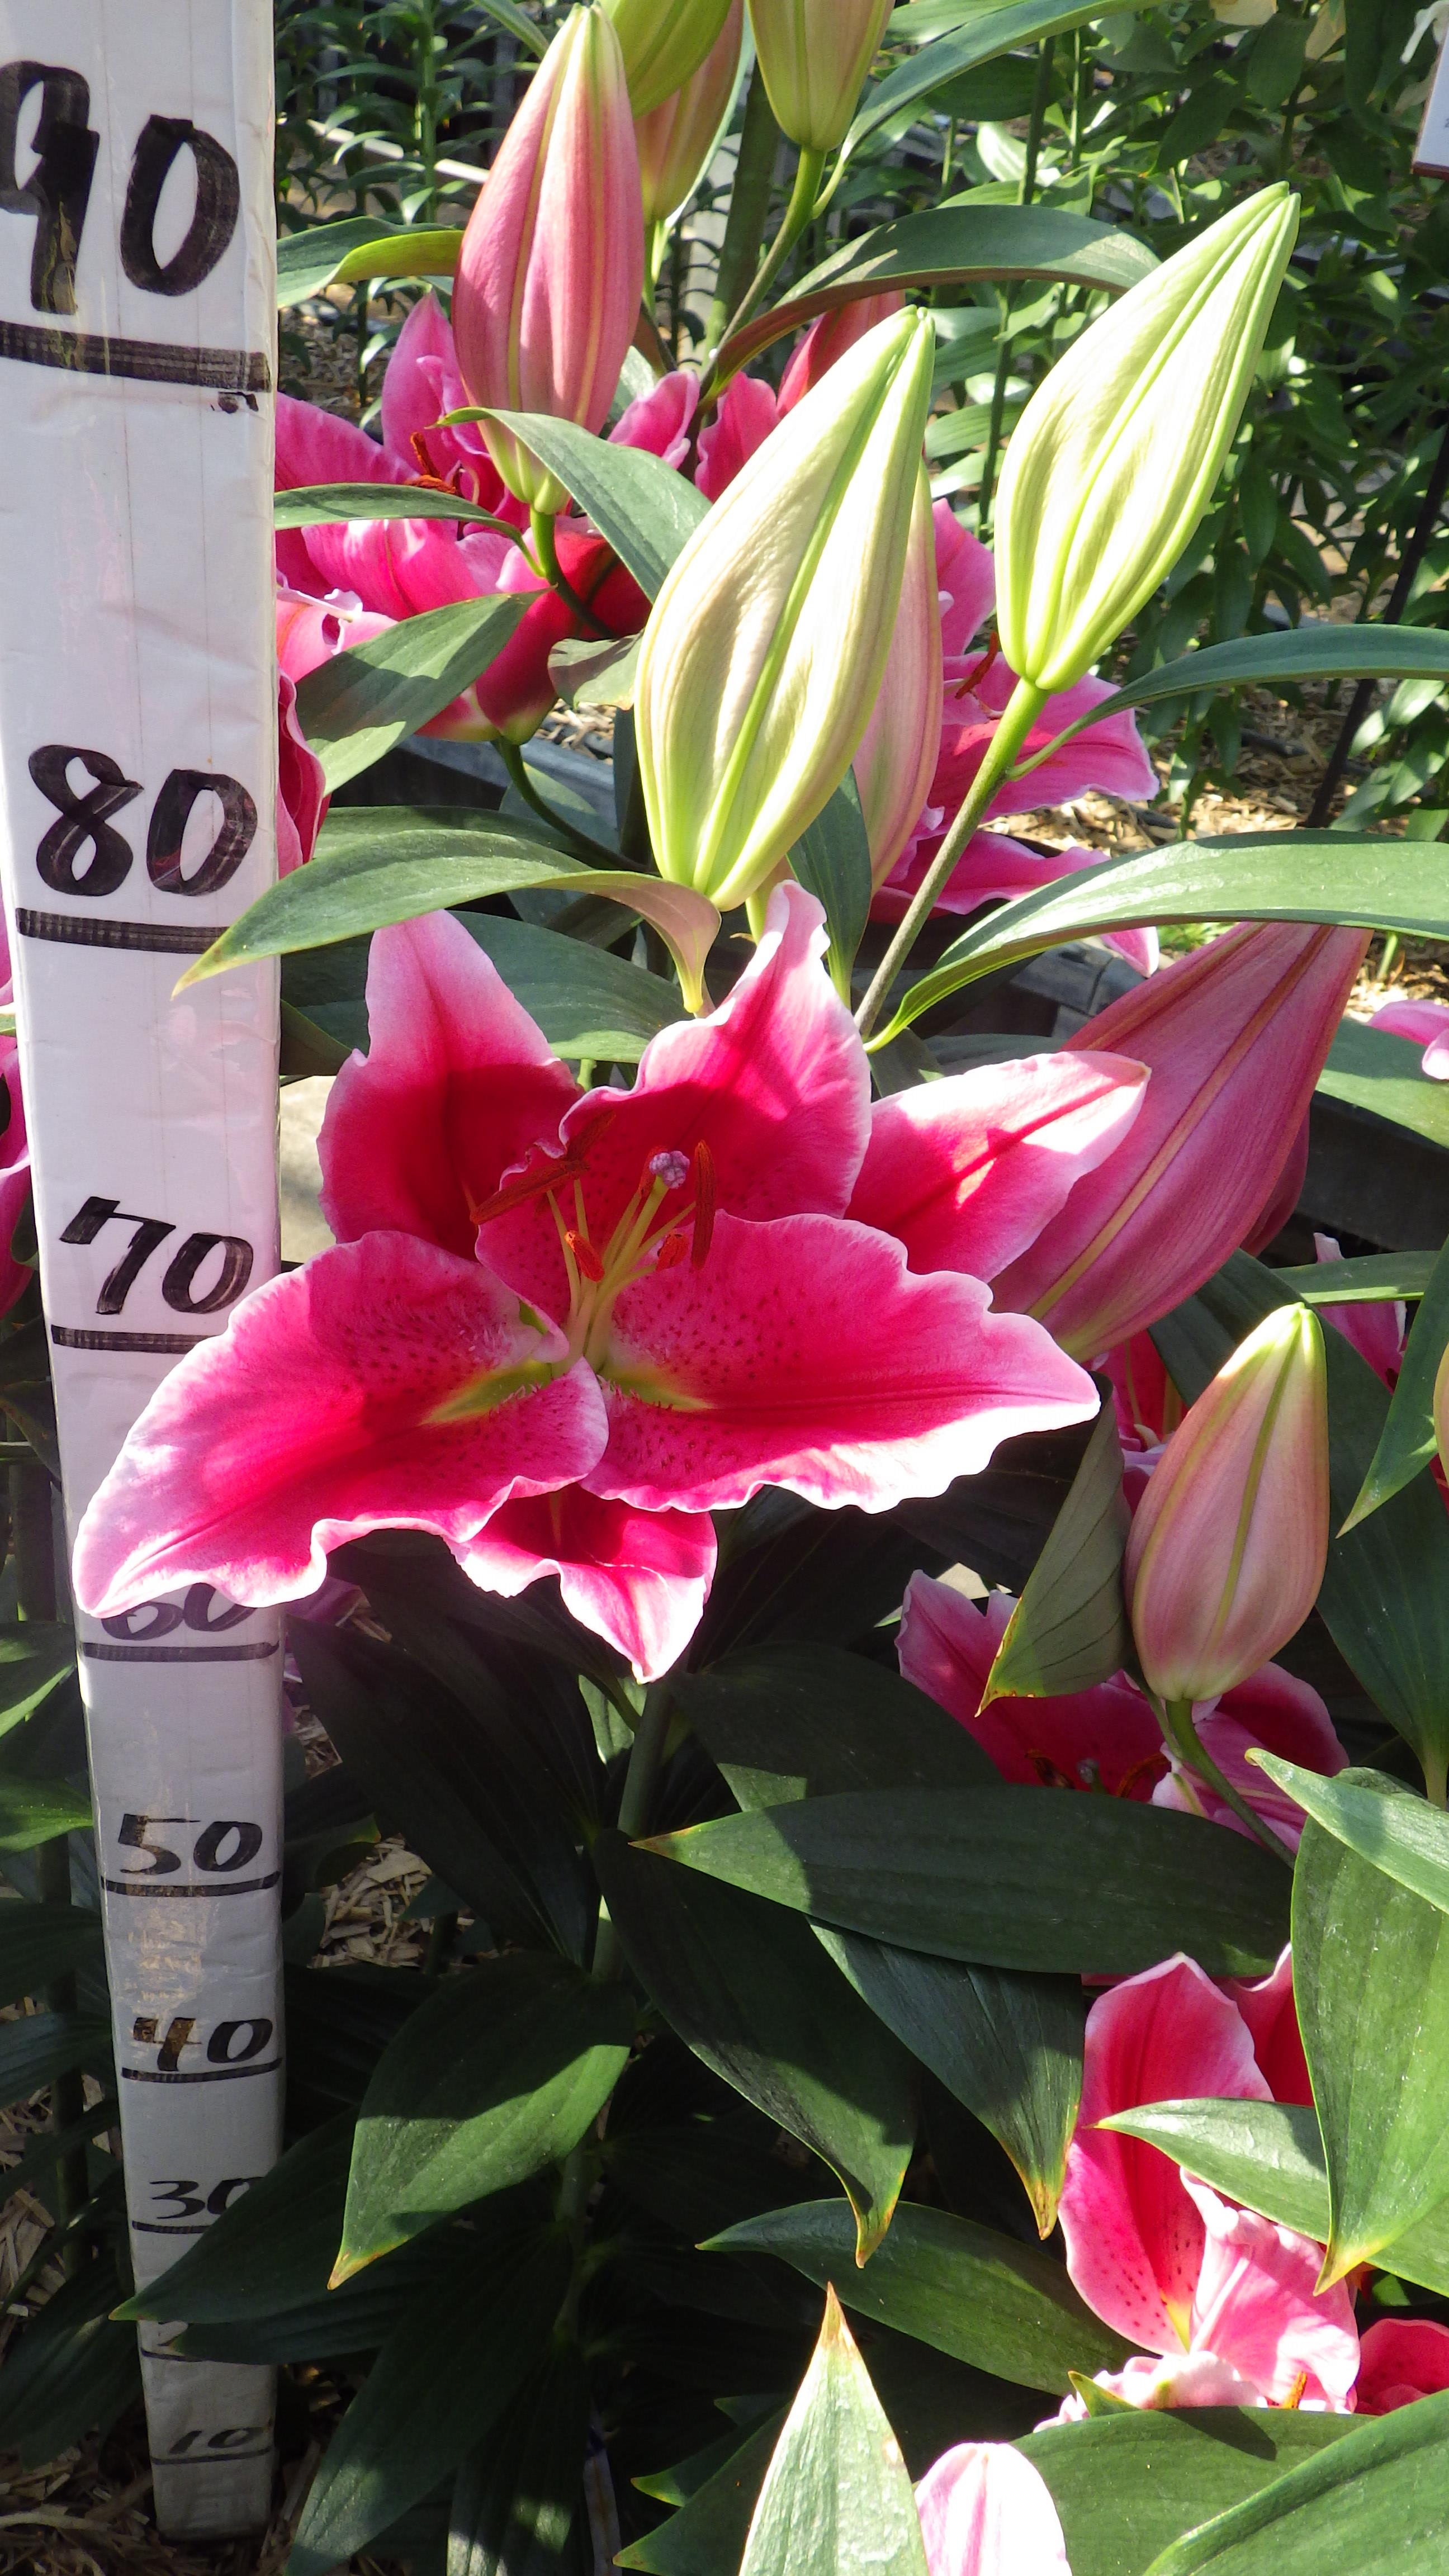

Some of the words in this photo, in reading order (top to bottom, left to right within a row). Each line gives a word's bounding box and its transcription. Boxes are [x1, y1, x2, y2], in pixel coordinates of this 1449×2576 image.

[0, 60, 240, 315] 90
[29, 744, 258, 897] 80
[59, 1196, 253, 1315] 70
[118, 1813, 263, 1875] 50
[131, 2017, 273, 2072] 40
[169, 2427, 265, 2454] 10
